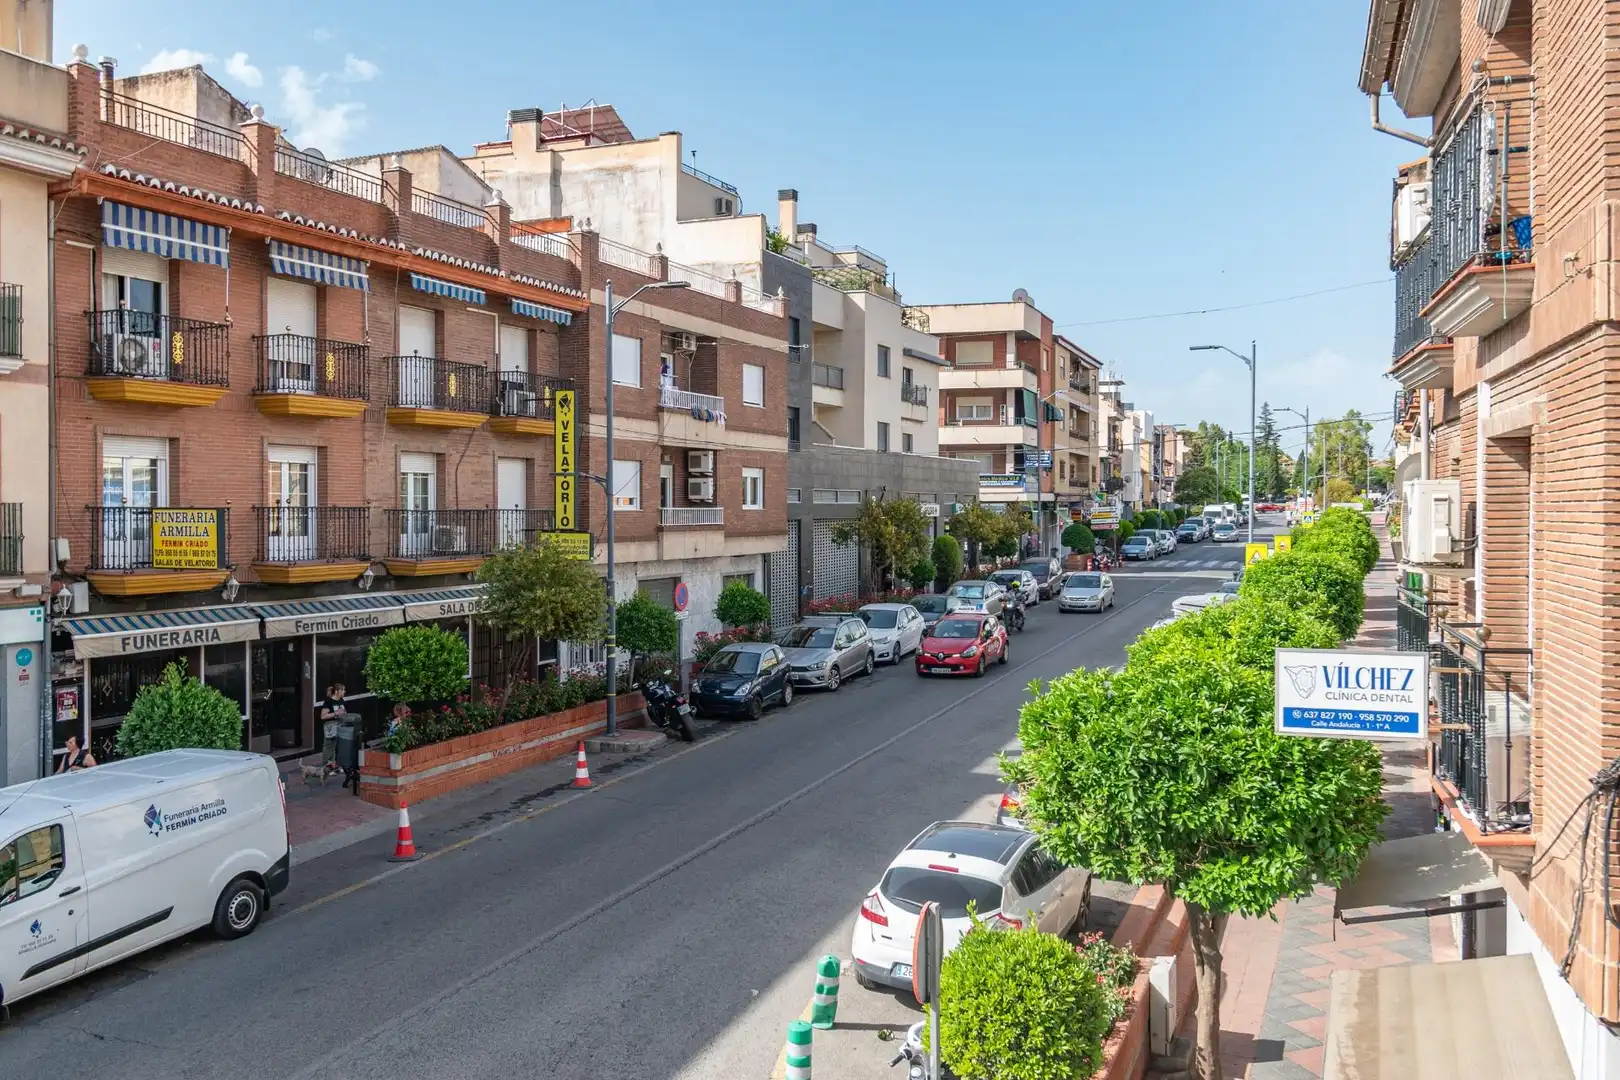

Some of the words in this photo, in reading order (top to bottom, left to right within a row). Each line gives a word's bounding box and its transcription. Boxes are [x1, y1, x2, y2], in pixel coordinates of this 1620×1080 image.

[560, 420, 570, 527] VELATORIO
[154, 511, 215, 523] FUNERARIA
[160, 525, 210, 537] ARMILLA
[440, 603, 466, 616] SALA
[295, 618, 338, 633] Fermín
[342, 614, 379, 628] Criado
[121, 628, 221, 652] FUNERARIA
[1322, 661, 1415, 692] VÍLCHEZ
[1325, 691, 1368, 702] CLÍNICA
[1371, 693, 1413, 704] DENTAL
[1304, 711, 1318, 719] 637
[1320, 712, 1335, 720] 827
[1338, 712, 1352, 720] 190
[1359, 713, 1374, 721] 958
[1376, 714, 1391, 722] 570
[1393, 715, 1409, 723] 290
[164, 806, 200, 823] Funeraria
[200, 798, 225, 812] Armilla
[165, 816, 197, 833] FERMÍN
[198, 807, 227, 822] CRIADO
